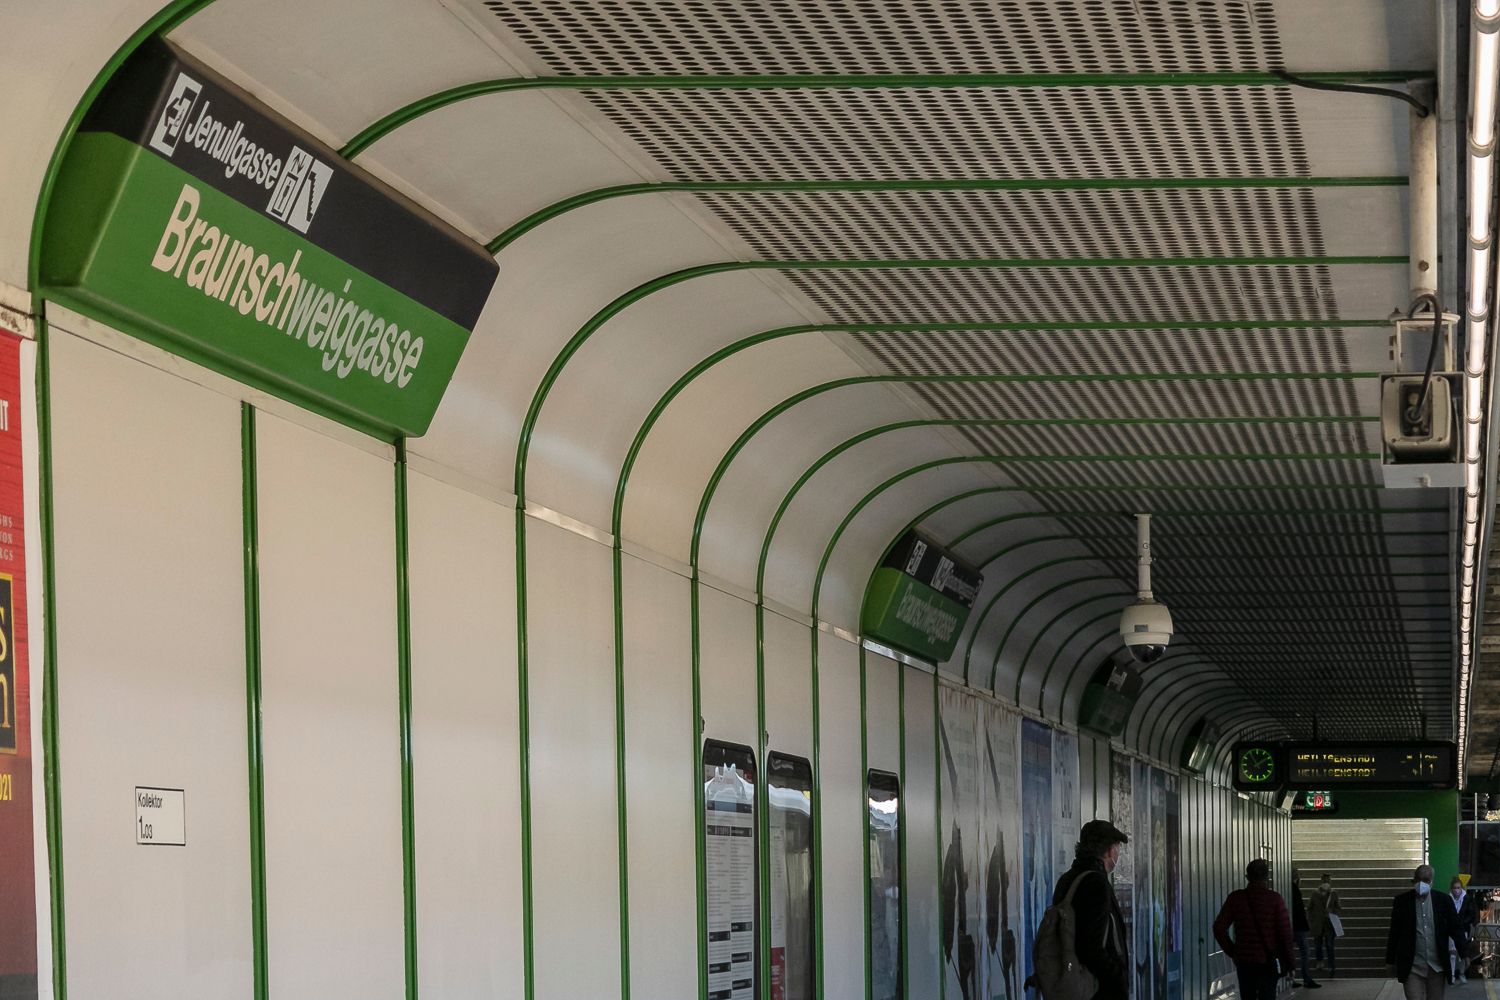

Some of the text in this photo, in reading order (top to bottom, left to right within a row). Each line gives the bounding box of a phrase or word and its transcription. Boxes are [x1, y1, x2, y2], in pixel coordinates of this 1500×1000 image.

[185, 100, 282, 190] Jenullgasse
[151, 183, 424, 389] Braunschweiggasse
[138, 792, 163, 809] Kollektor
